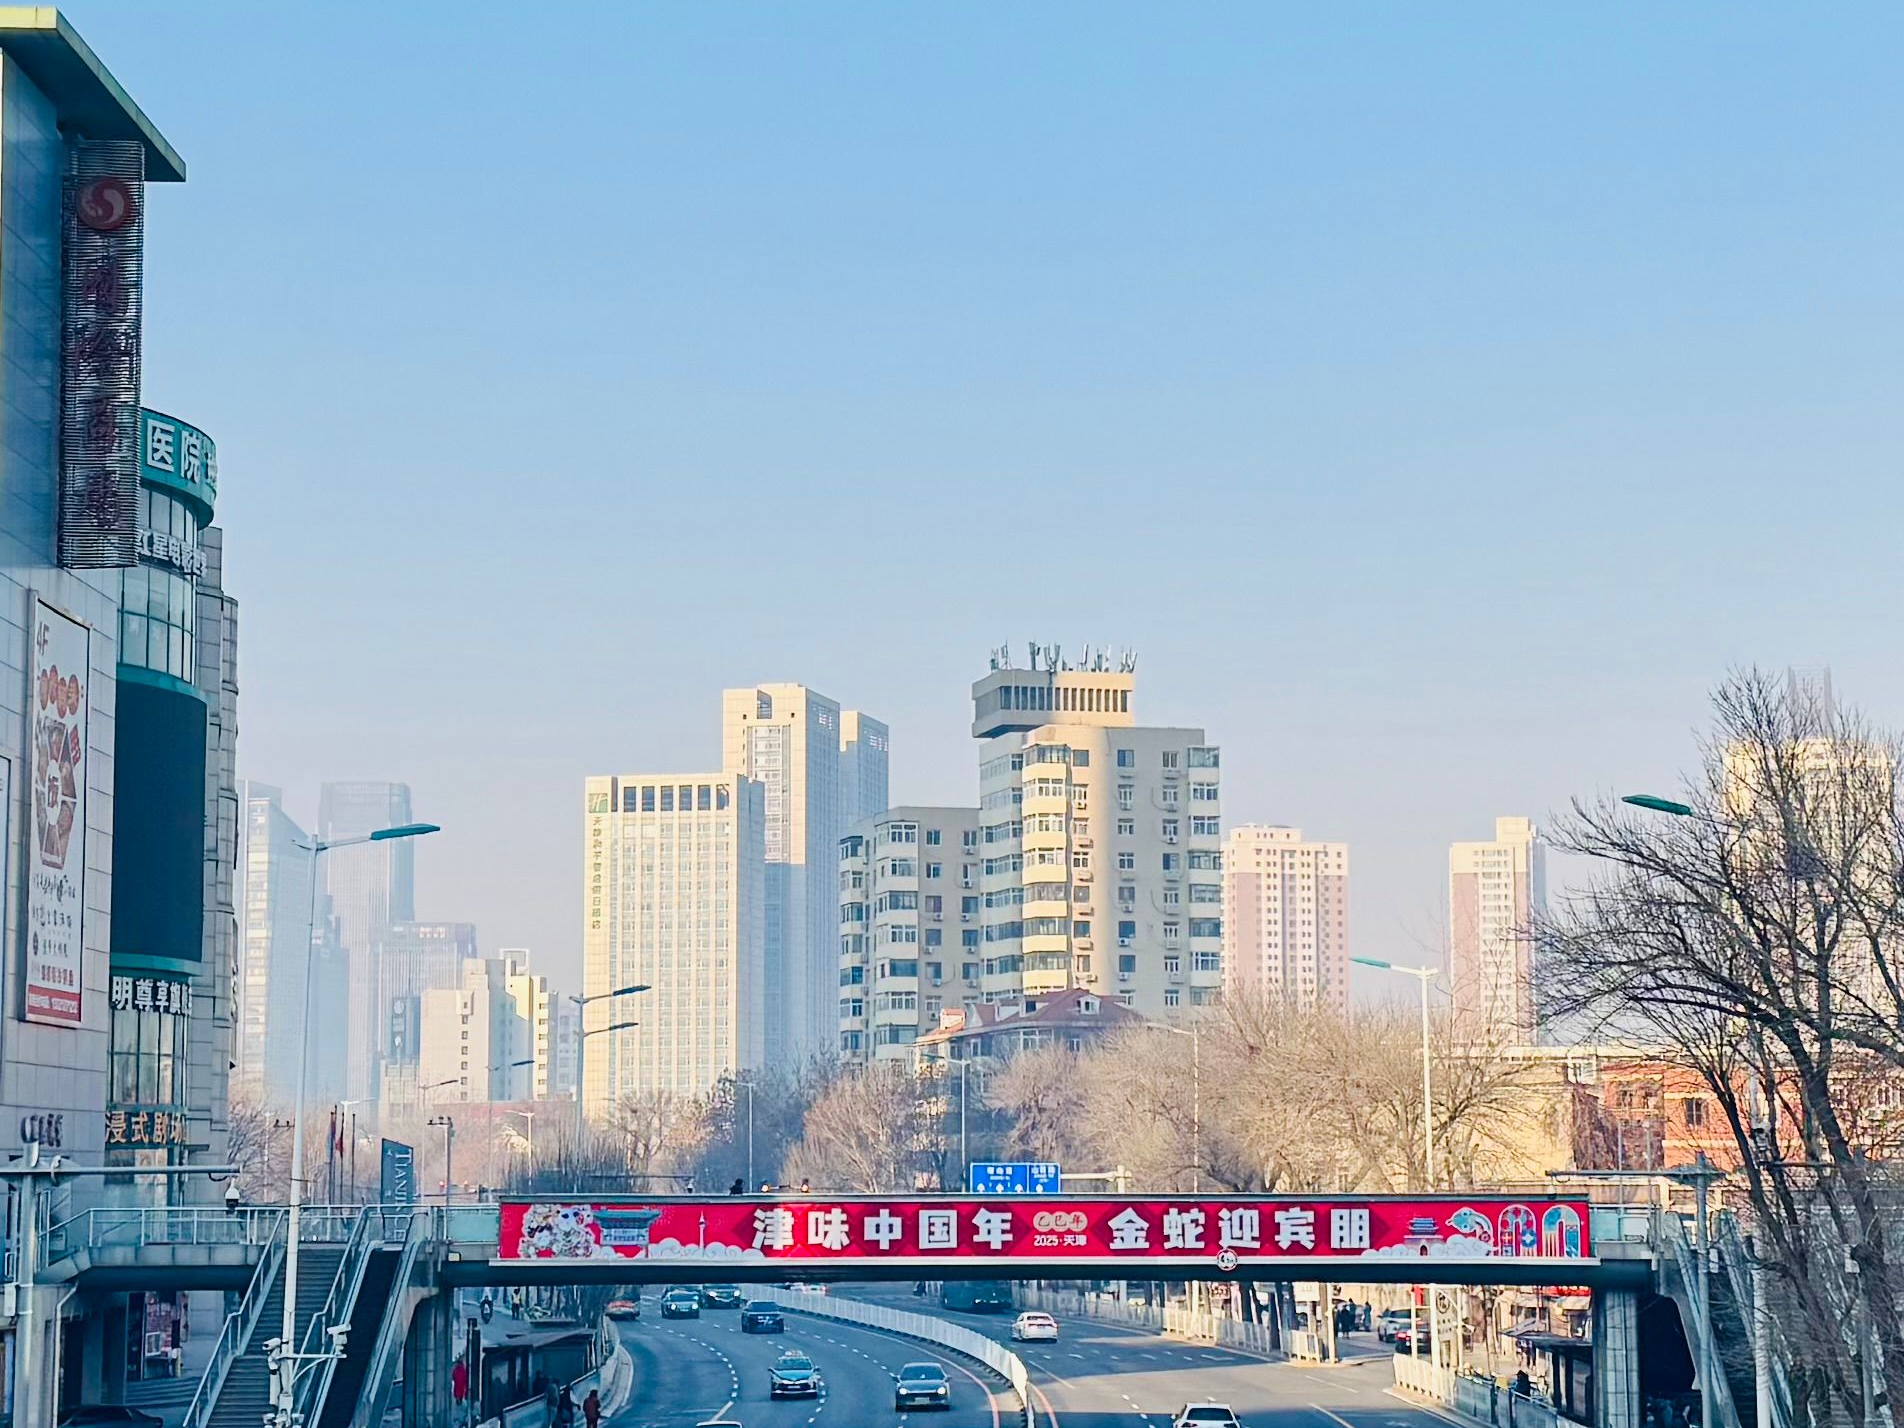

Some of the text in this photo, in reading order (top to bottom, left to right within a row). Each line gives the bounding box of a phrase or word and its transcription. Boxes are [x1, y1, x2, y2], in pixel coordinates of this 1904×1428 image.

[751, 1206, 1015, 1252] 津味中国年
[1106, 1205, 1372, 1252] 金蛇迎宾朋
